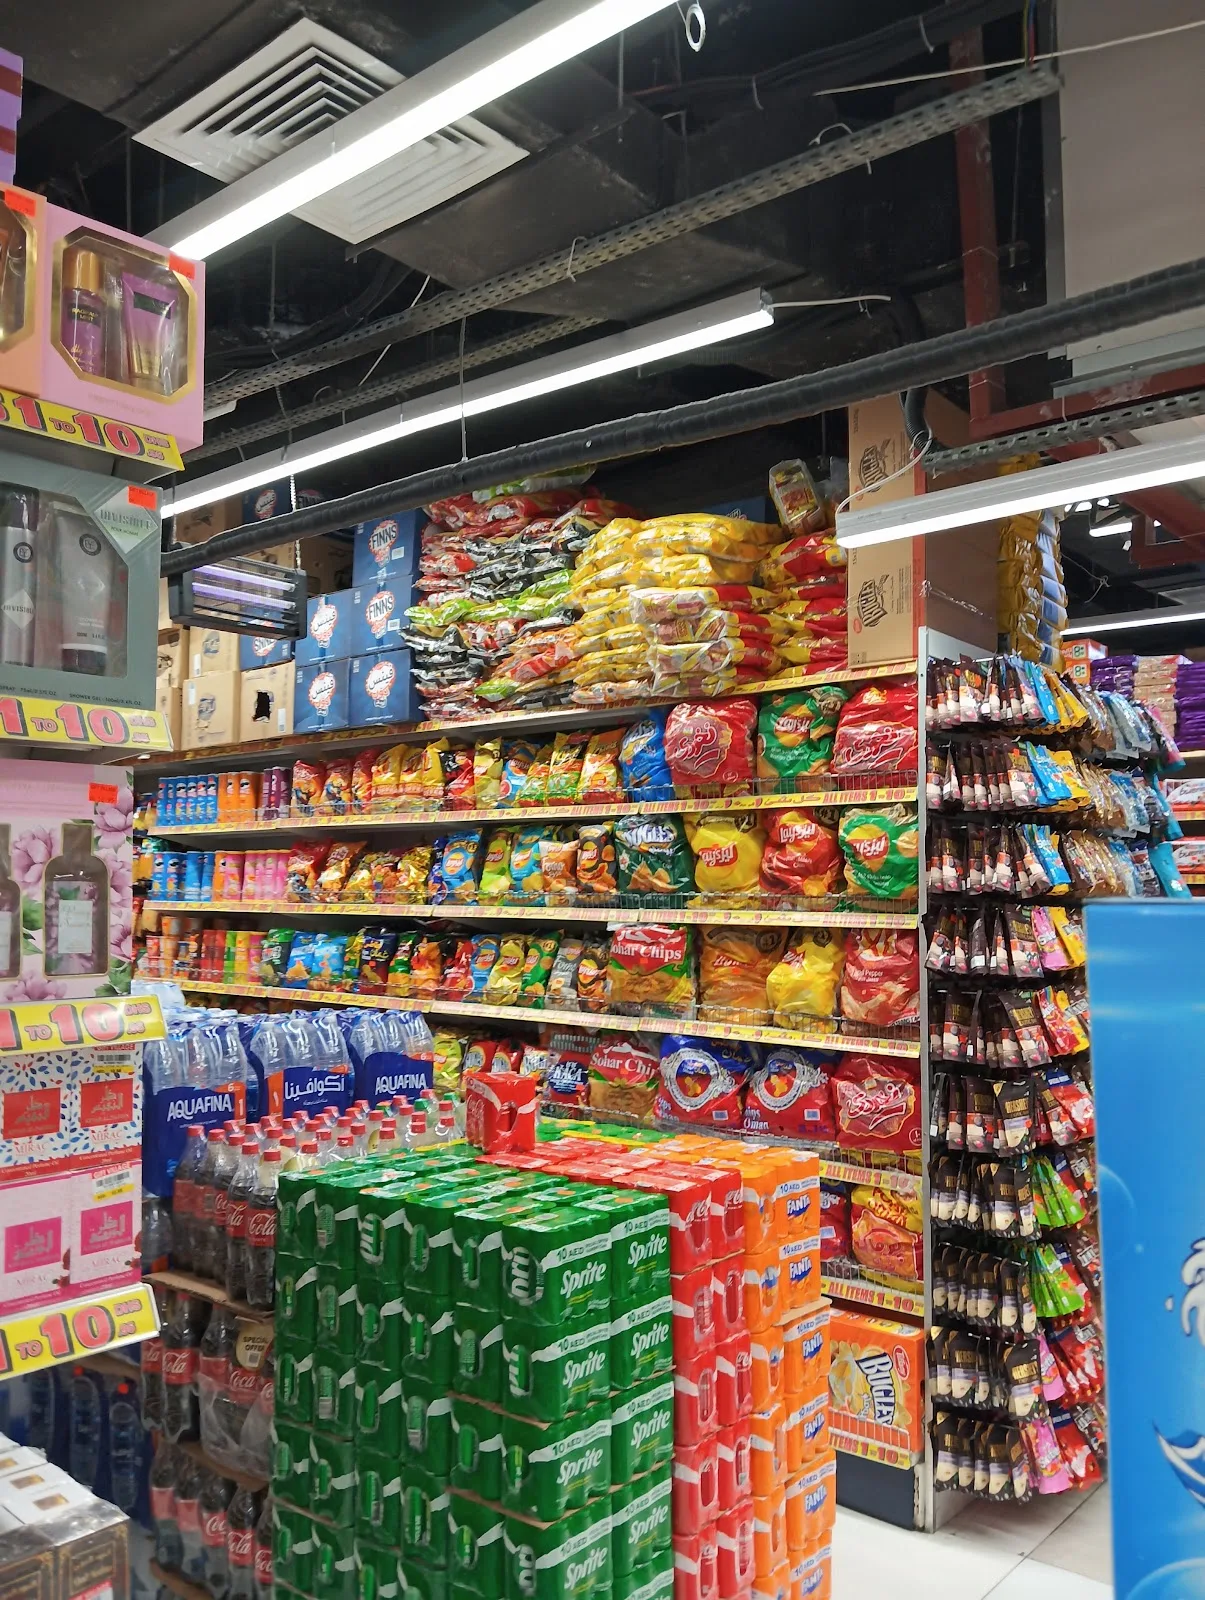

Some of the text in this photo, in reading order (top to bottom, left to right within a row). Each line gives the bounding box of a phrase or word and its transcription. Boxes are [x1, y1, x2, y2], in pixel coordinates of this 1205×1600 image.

[49, 418, 76, 434] TO
[72, 412, 145, 456] 10
[371, 524, 398, 549] FINNS
[367, 595, 395, 618] FINNS
[31, 717, 59, 733] TO
[55, 703, 130, 746] 10
[823, 788, 906, 804] ALL ITEMS 1 10
[640, 943, 683, 963] Chips
[24, 1024, 52, 1042] TO
[50, 1003, 126, 1045] 10
[591, 1052, 622, 1070] Sohar
[227, 1083, 234, 1091] 6
[284, 1074, 345, 1101] أكوافينا
[375, 1072, 427, 1096] AQUAFINA
[167, 1093, 232, 1121] AQUAFINA
[826, 1165, 841, 1178] ALL
[842, 1167, 872, 1184] ITEMS
[873, 1172, 882, 1185] 1
[780, 1184, 788, 1194] 10
[787, 1195, 810, 1215] FANTA
[249, 1212, 276, 1237] Cola
[625, 1220, 648, 1233] 10 AED
[557, 1246, 584, 1261] 10 AED
[628, 1233, 667, 1268] Sprite
[783, 1245, 791, 1255] 10
[560, 1261, 606, 1298] Sprite
[790, 1256, 812, 1278] FANTA
[828, 1281, 915, 1310] ALL ITEMS 1 10
[15, 1305, 115, 1361] TO 10
[559, 1339, 569, 1352] 10
[631, 1322, 669, 1359] Sprite
[803, 1332, 823, 1357] FANTA
[245, 1344, 264, 1352] OFFER
[230, 1370, 257, 1391] Coca
[563, 1350, 606, 1388] Sprite
[631, 1409, 671, 1449] Sprite
[804, 1413, 825, 1437] FANTA
[553, 1443, 565, 1456] 10
[829, 1434, 898, 1464] ITEMS 1 10
[557, 1448, 603, 1487] Sprite
[805, 1485, 828, 1512] FANTA
[628, 1505, 669, 1544] Sprite
[564, 1547, 608, 1591] Sprite
[803, 1568, 824, 1593] FANTA
